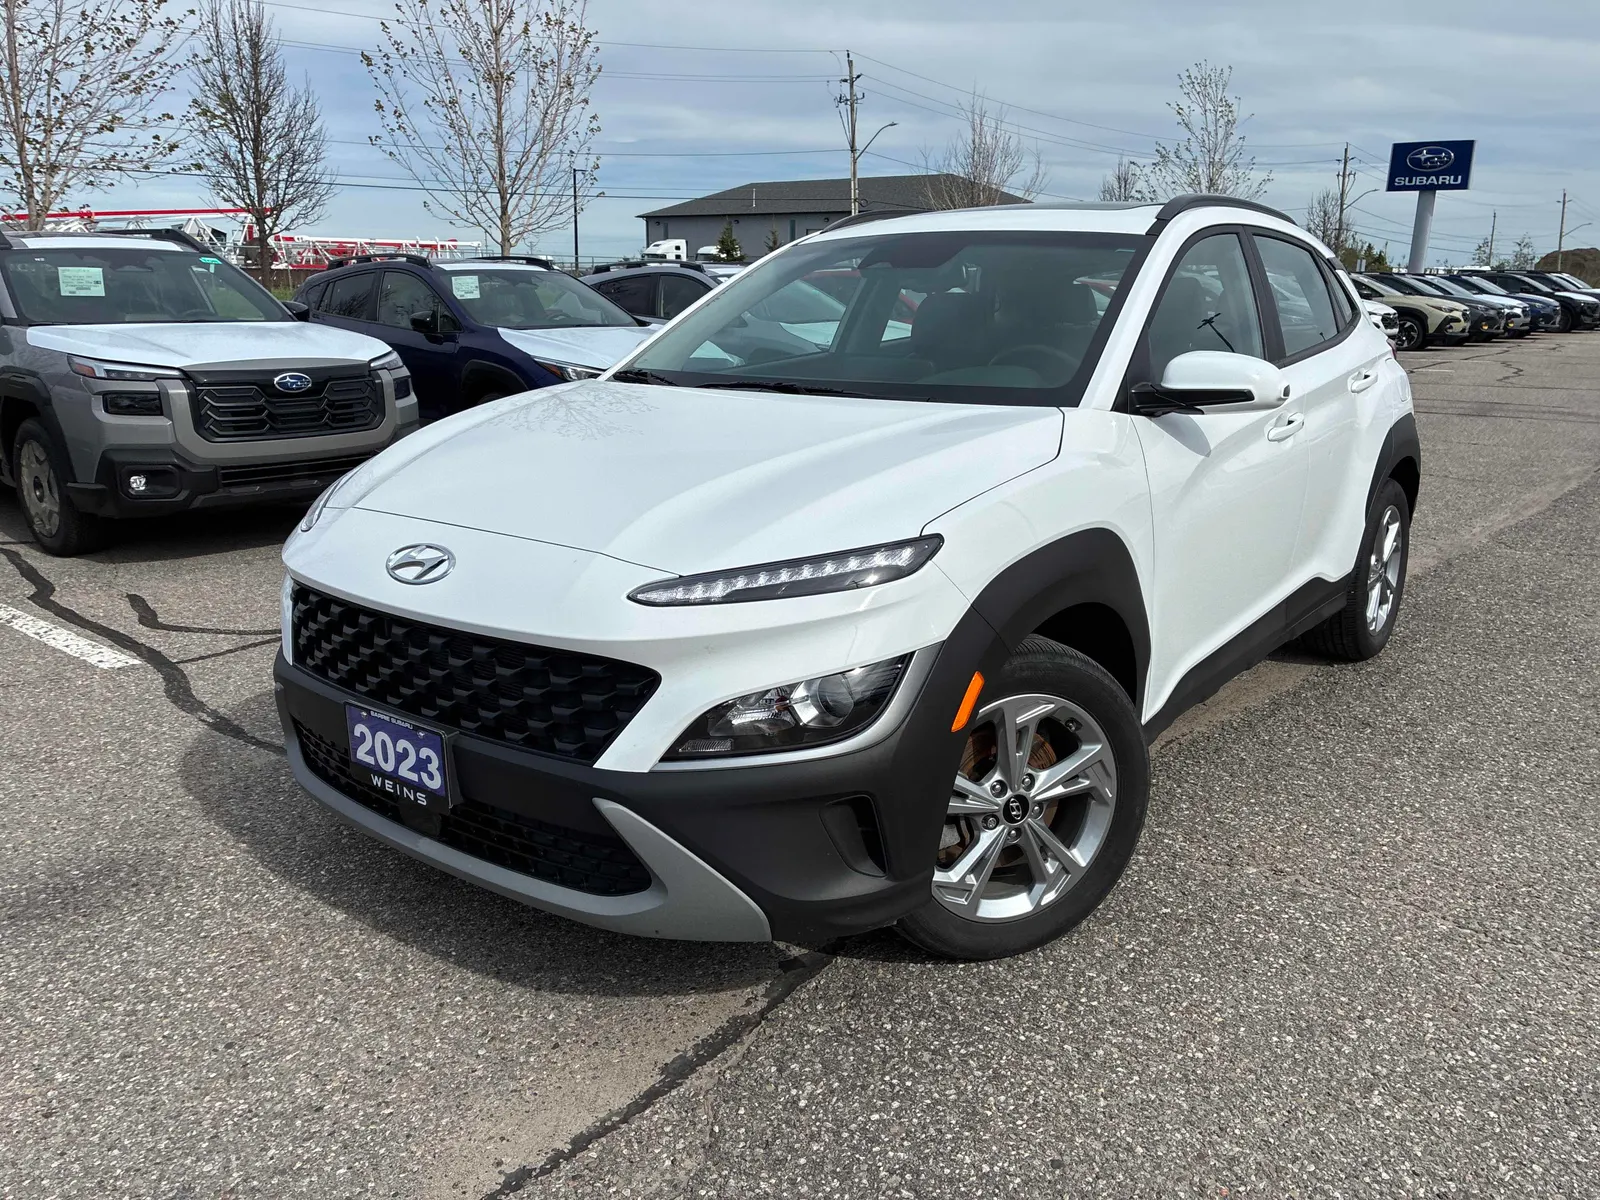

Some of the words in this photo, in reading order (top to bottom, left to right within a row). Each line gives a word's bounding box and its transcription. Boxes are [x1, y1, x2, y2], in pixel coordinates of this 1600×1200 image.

[1394, 175, 1462, 186] SUBARU
[354, 723, 441, 789] 2023
[370, 773, 427, 806] WEINS
